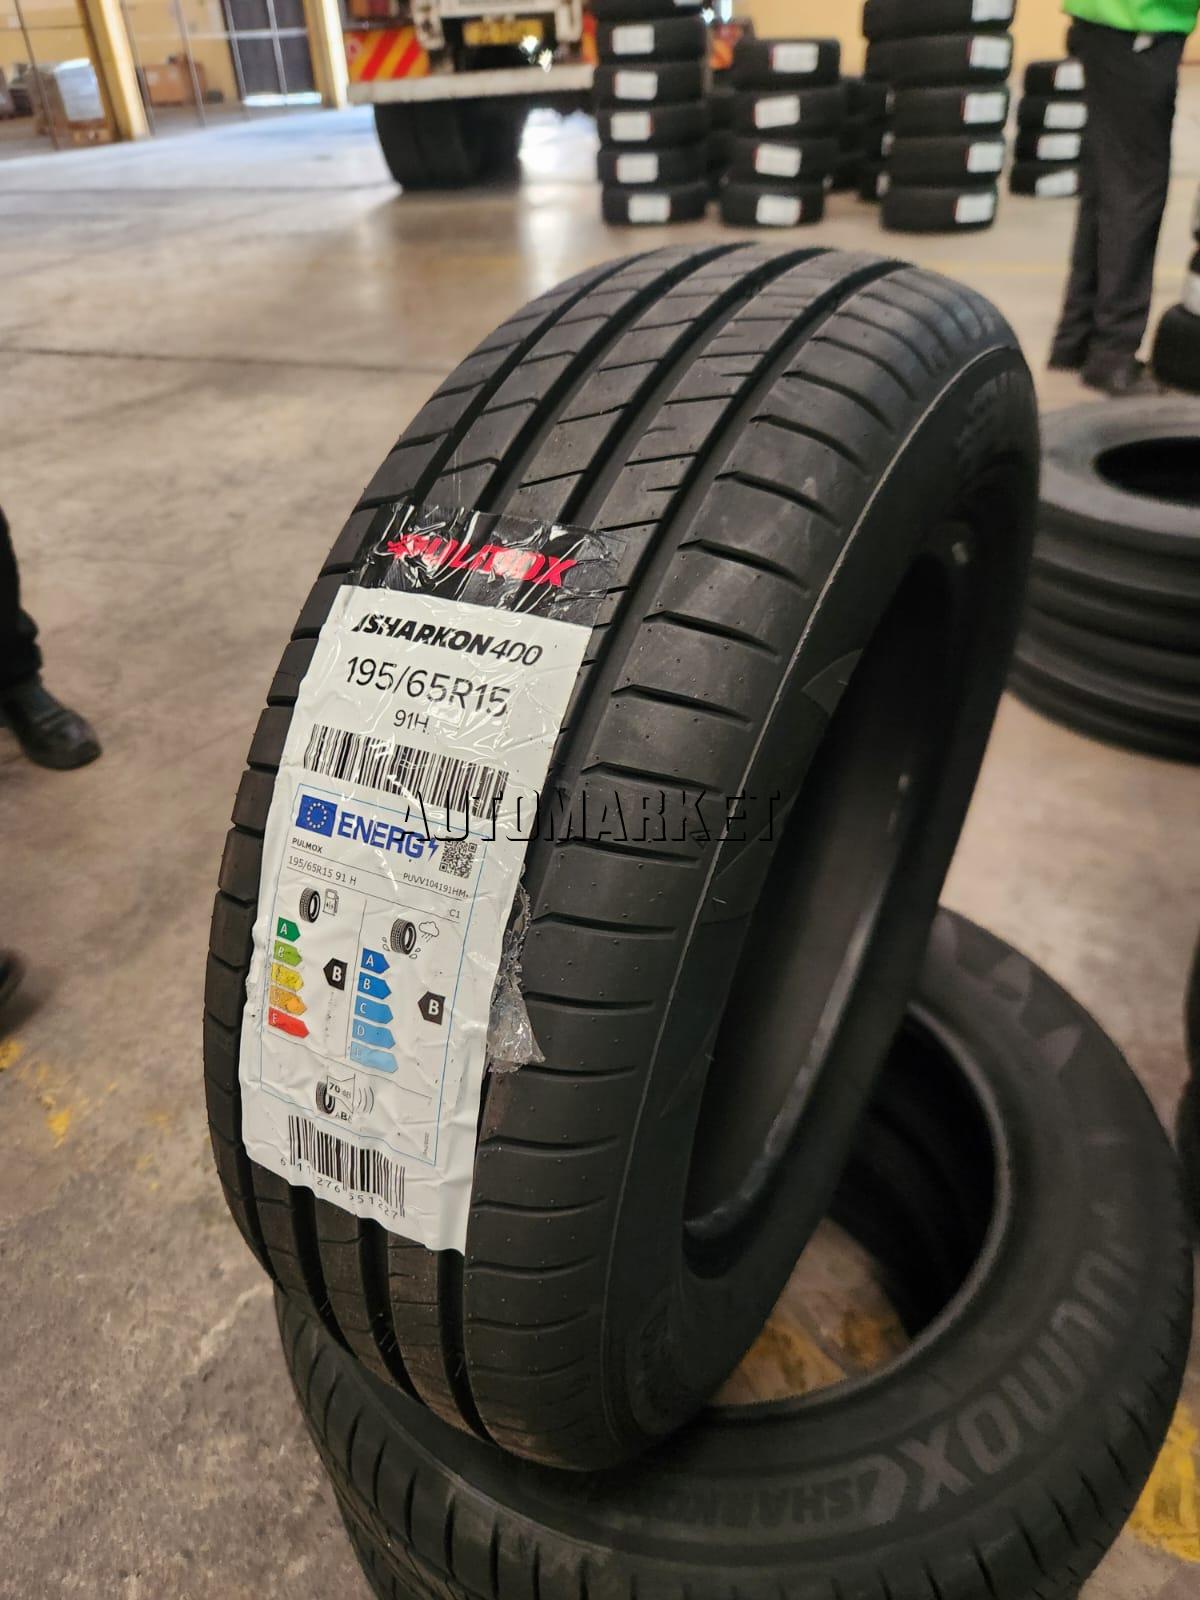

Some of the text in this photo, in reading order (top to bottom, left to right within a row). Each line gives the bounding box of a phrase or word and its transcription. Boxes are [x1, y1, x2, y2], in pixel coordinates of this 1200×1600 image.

[346, 656, 510, 718] 195/65R15
[393, 709, 429, 733] 91H
[337, 811, 424, 859] ENERG
[292, 837, 323, 853] PULMOX
[288, 855, 356, 886] 195/65R15 91 H
[450, 909, 460, 919] C1
[280, 922, 288, 935] A
[365, 954, 374, 967] A
[332, 965, 341, 982] B
[363, 978, 371, 989] B
[360, 1002, 366, 1013] C
[428, 1000, 439, 1015] B
[357, 1025, 364, 1036] D
[329, 1082, 340, 1093] 70
[281, 1158, 287, 1166] 6
